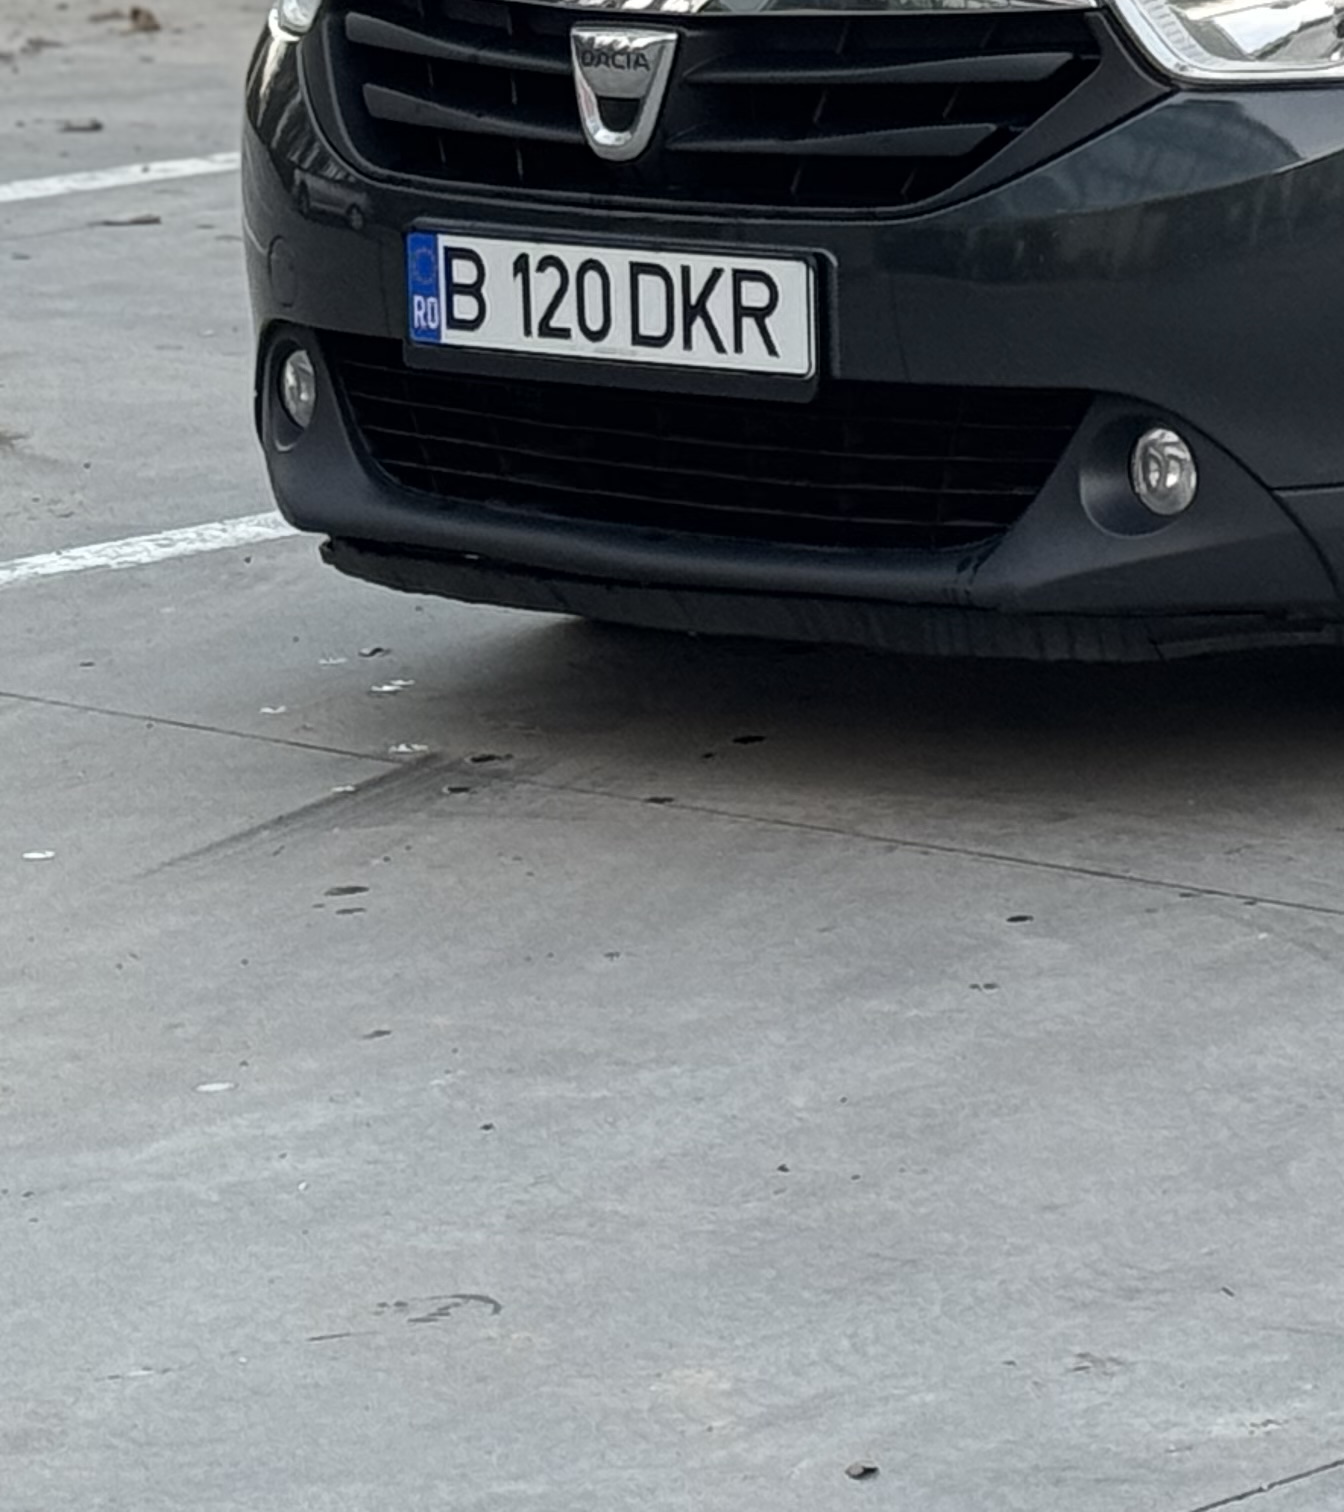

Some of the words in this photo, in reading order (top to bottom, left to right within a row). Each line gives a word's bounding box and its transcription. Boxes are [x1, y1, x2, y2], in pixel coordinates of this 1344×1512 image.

[580, 49, 651, 72] DACIA
[413, 294, 439, 330] RO
[444, 246, 486, 332] B
[513, 252, 611, 343] 120
[629, 260, 780, 359] DKR
